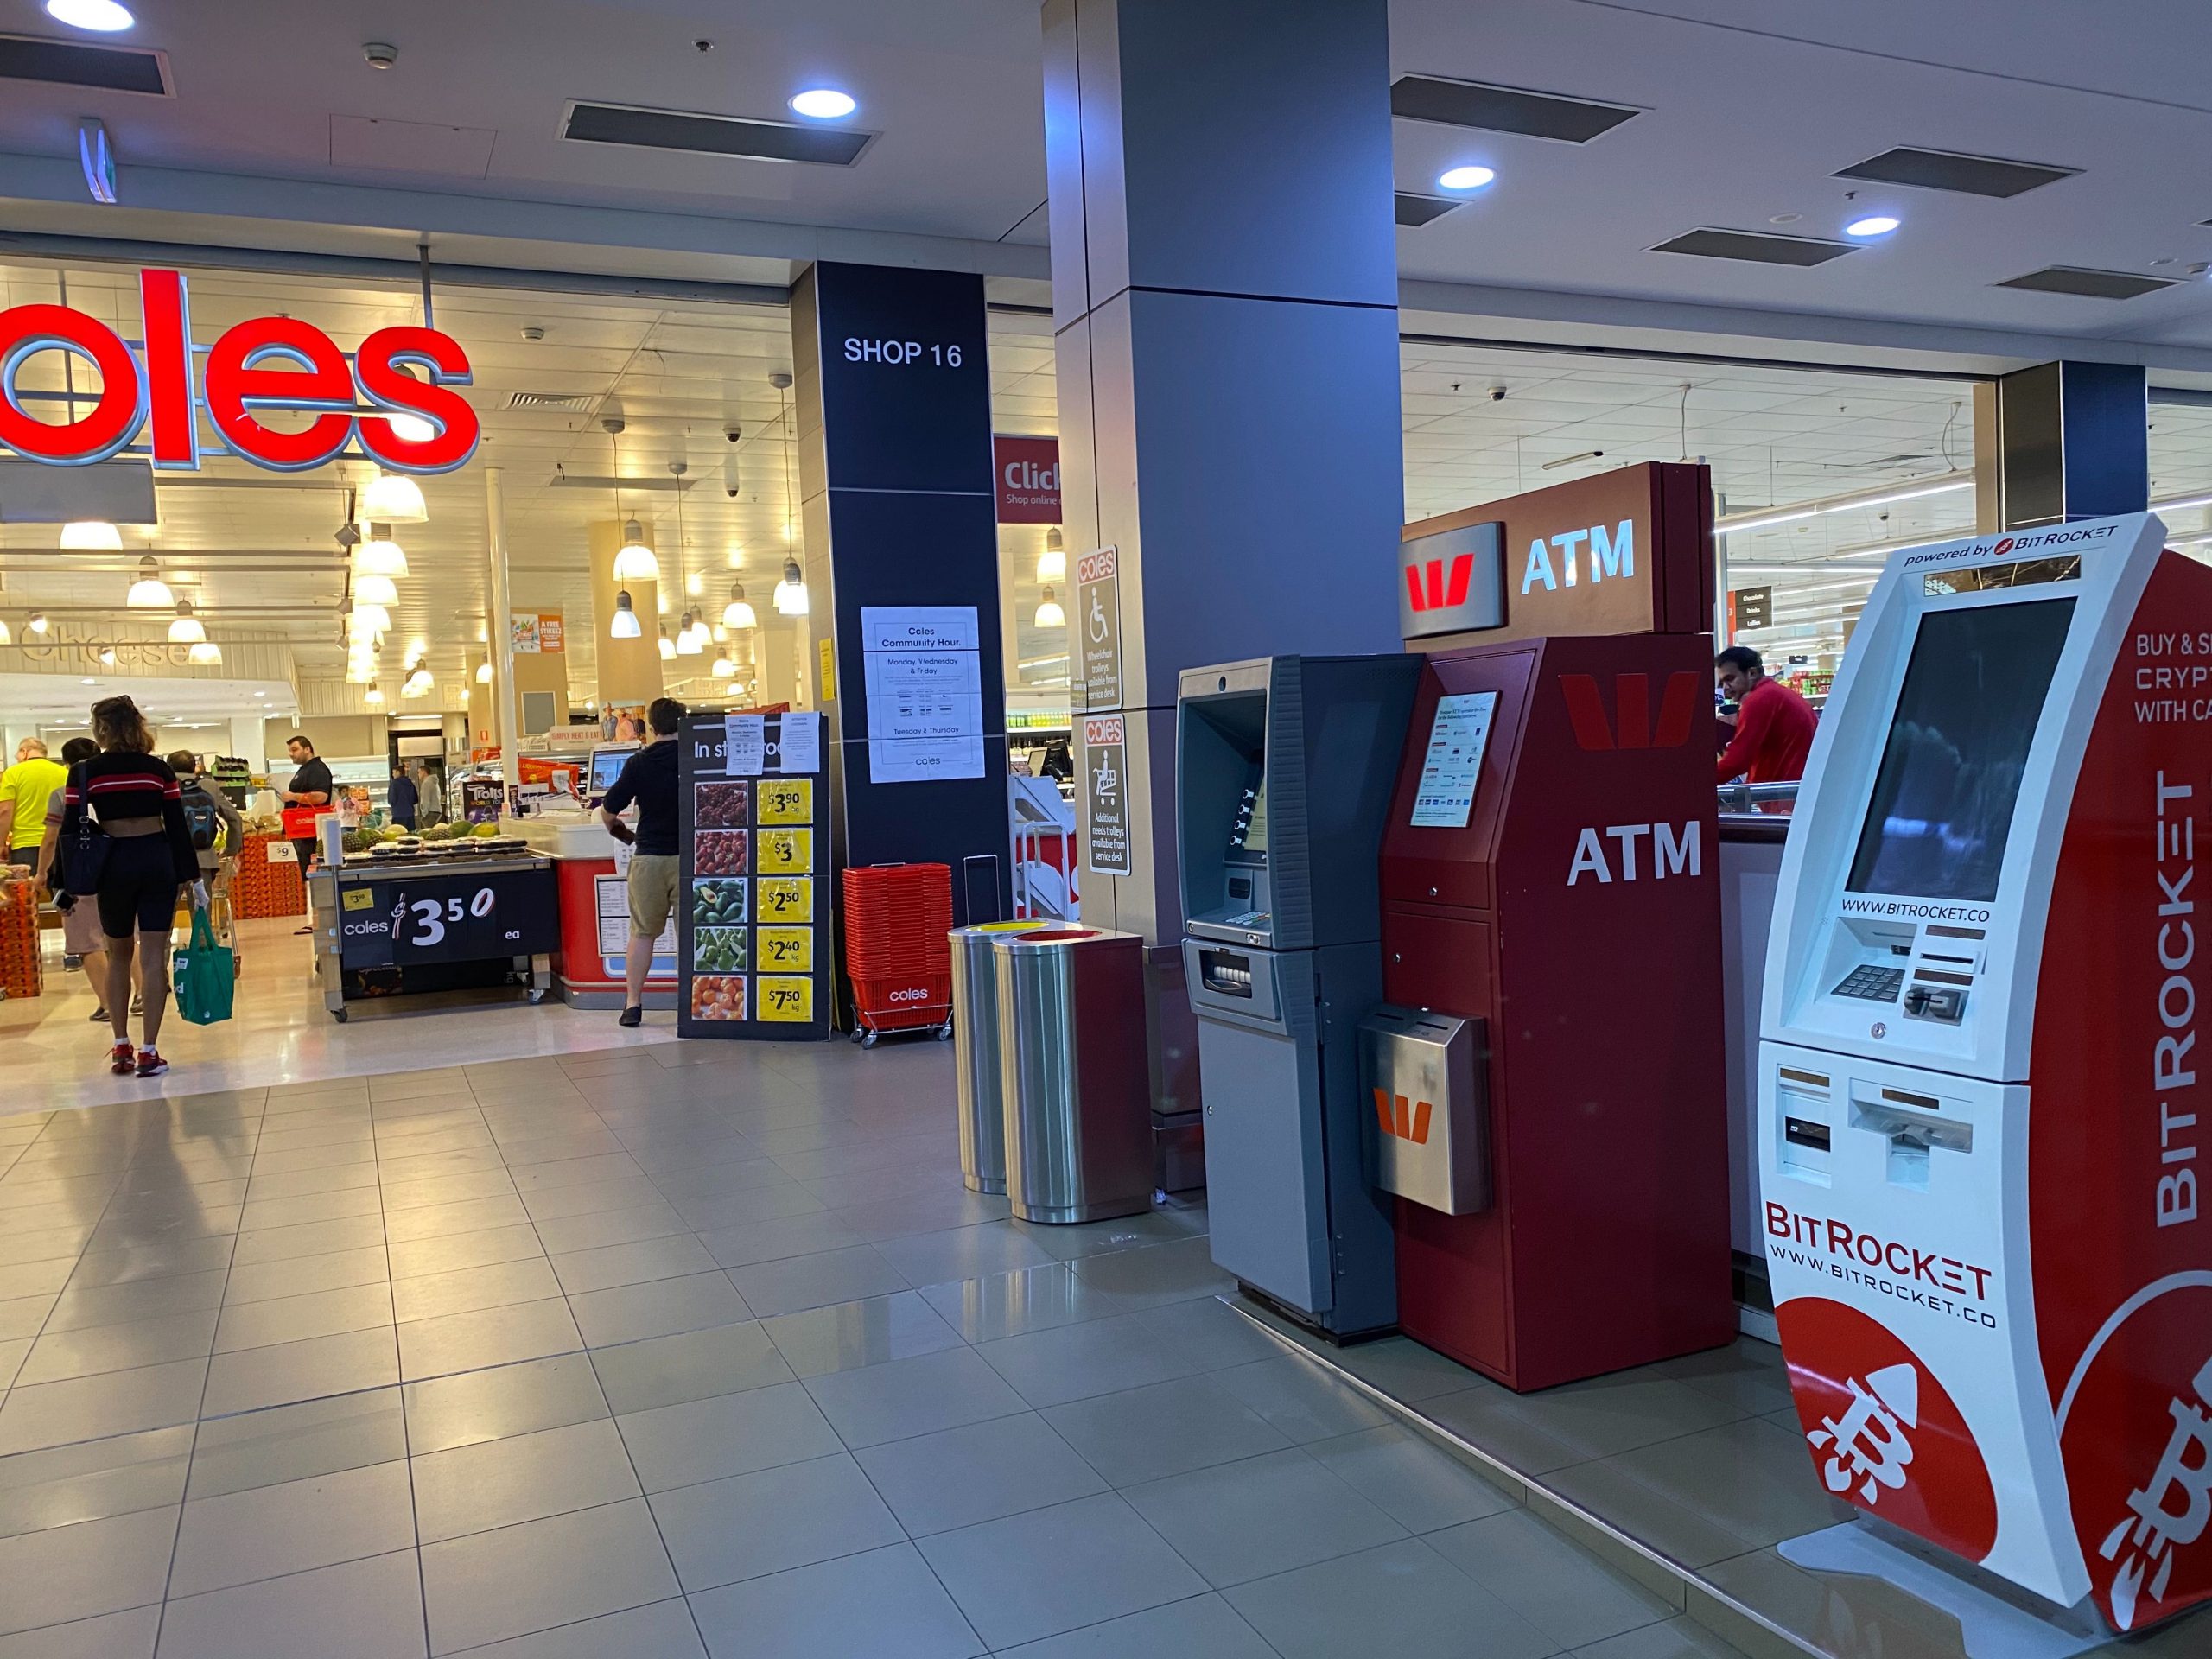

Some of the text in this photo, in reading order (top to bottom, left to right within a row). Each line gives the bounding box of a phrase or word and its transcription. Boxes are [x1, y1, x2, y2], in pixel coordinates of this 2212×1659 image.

[844, 337, 962, 368] SHOP 16
[1006, 493, 1029, 506] Shop
[1030, 495, 1058, 505] online
[1521, 518, 1634, 595] ATM
[1904, 546, 1970, 567] powered
[1973, 543, 1993, 556] by
[1078, 552, 1115, 582] coles
[881, 638, 961, 648] Community Hour.
[2137, 633, 2176, 656] BUY
[2181, 632, 2193, 655] &
[1086, 649, 1113, 662] Wheelchair
[1091, 663, 1109, 674] trolleys
[1088, 676, 1117, 688] vailable from
[1088, 690, 1104, 700] service
[1104, 687, 1116, 698] desk
[2134, 699, 2187, 724] WITH
[1086, 720, 1122, 743] coles
[694, 741, 709, 759] In
[467, 784, 503, 800] Trolls
[1095, 812, 1119, 823] Additional
[1092, 825, 1124, 838] needs trolleys
[1091, 837, 1126, 849] available from
[276, 847, 289, 857] $9
[774, 842, 792, 862] $3
[1095, 851, 1123, 862] service desk
[1567, 820, 1701, 887] ATM
[1842, 899, 1990, 923] WWW.BITROCKET.CO
[344, 920, 389, 936] coles
[505, 929, 520, 940] ea
[791, 953, 799, 962] kg
[889, 988, 928, 1001] coles
[791, 1003, 799, 1012] kg
[1770, 1244, 1996, 1329] WWW.BITROCKET.CO
